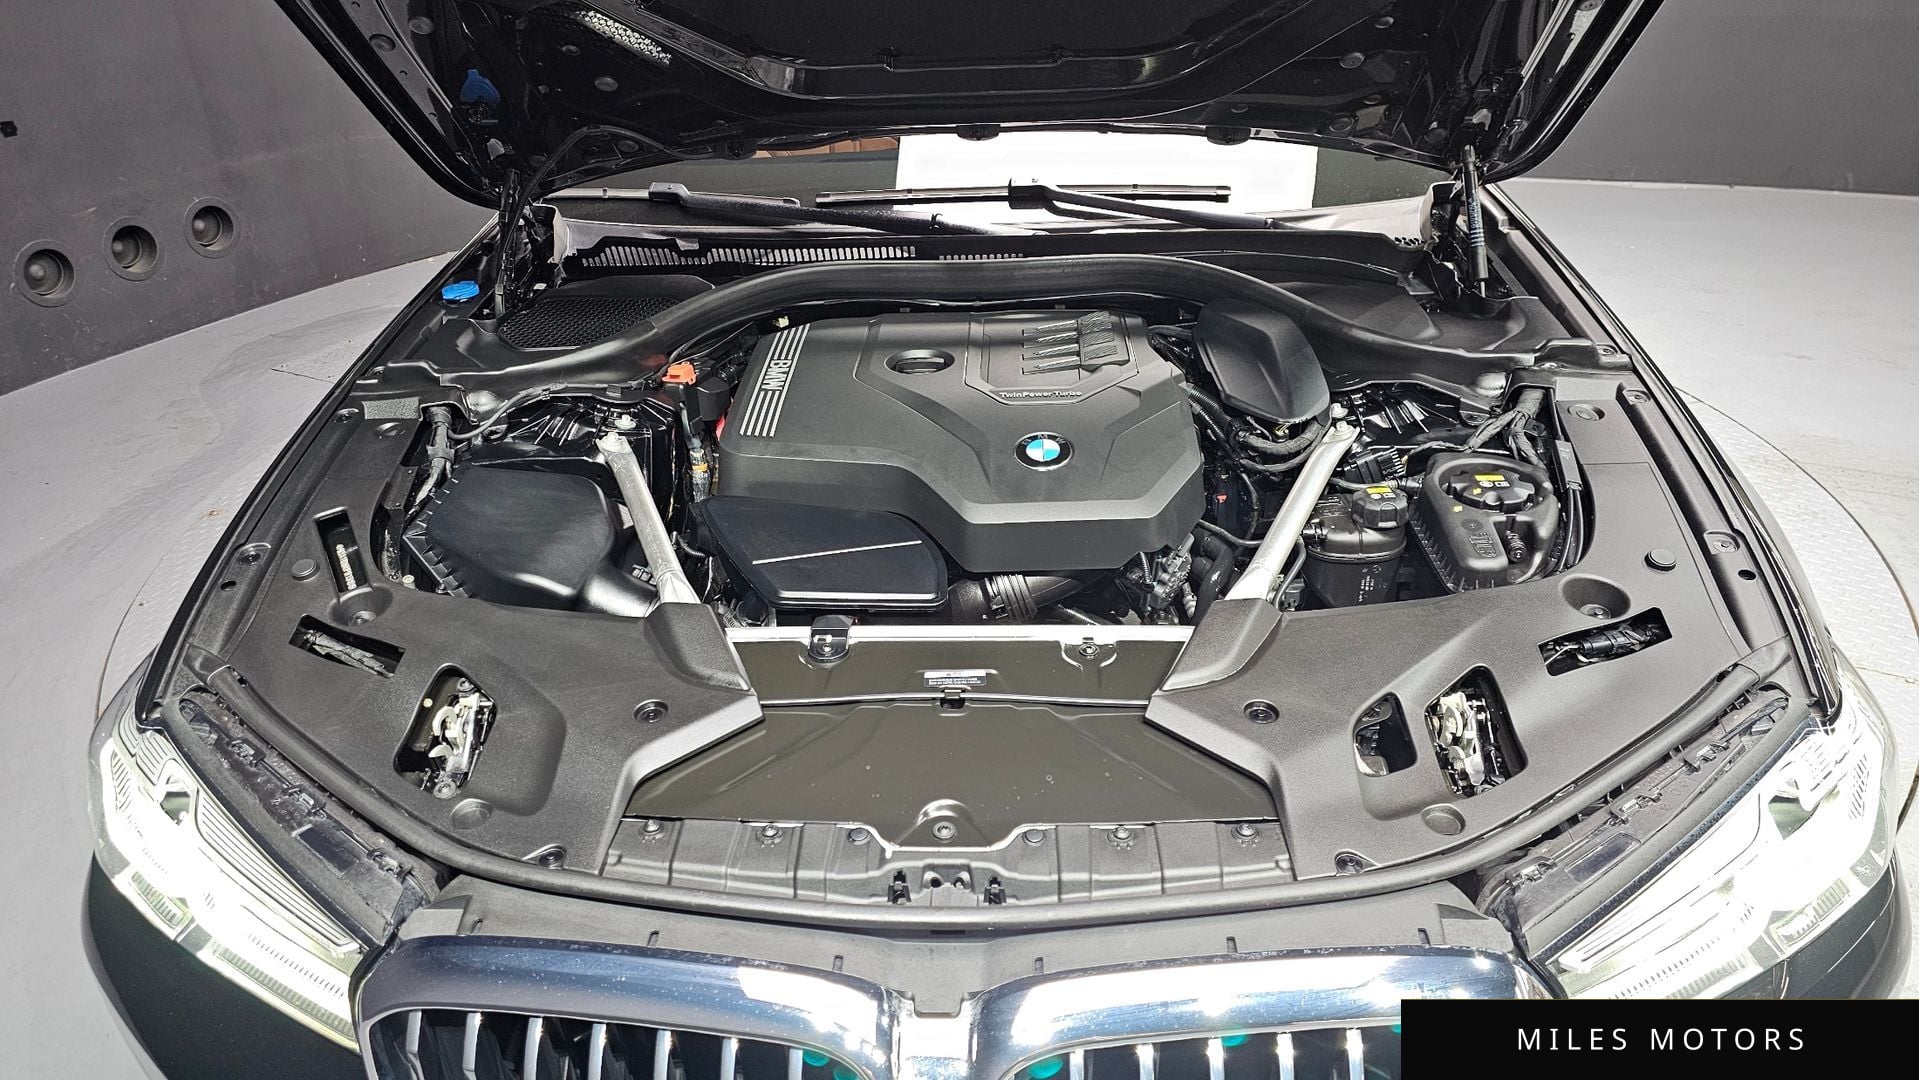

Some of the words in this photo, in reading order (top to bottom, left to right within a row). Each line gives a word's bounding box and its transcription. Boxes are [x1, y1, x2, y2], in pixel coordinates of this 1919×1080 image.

[761, 359, 792, 391] BMW
[999, 391, 1053, 399] TwinPower
[1053, 390, 1082, 398] Turbo
